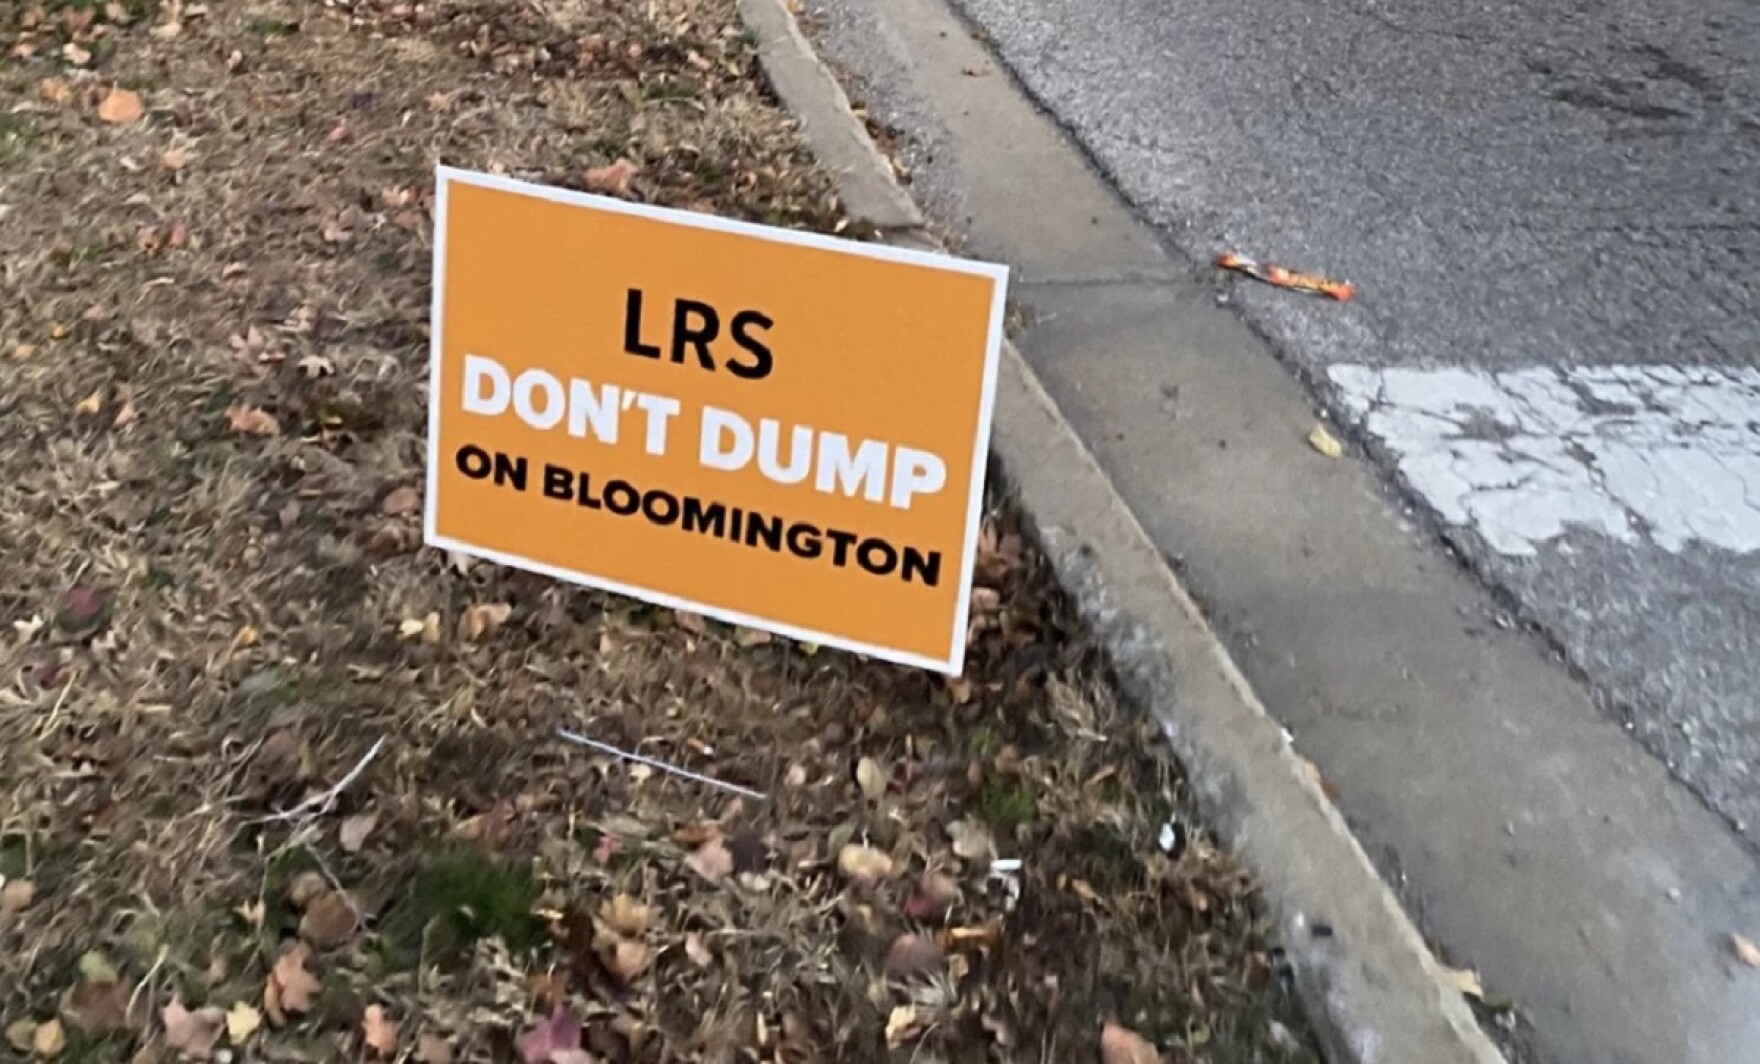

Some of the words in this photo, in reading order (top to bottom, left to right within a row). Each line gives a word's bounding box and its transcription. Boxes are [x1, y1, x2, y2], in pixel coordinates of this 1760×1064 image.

[623, 287, 775, 381] LRS
[461, 353, 683, 457] DON'T
[698, 404, 948, 511] DUMP
[455, 443, 528, 491] ON
[543, 462, 942, 588] BLOOMINGTON
